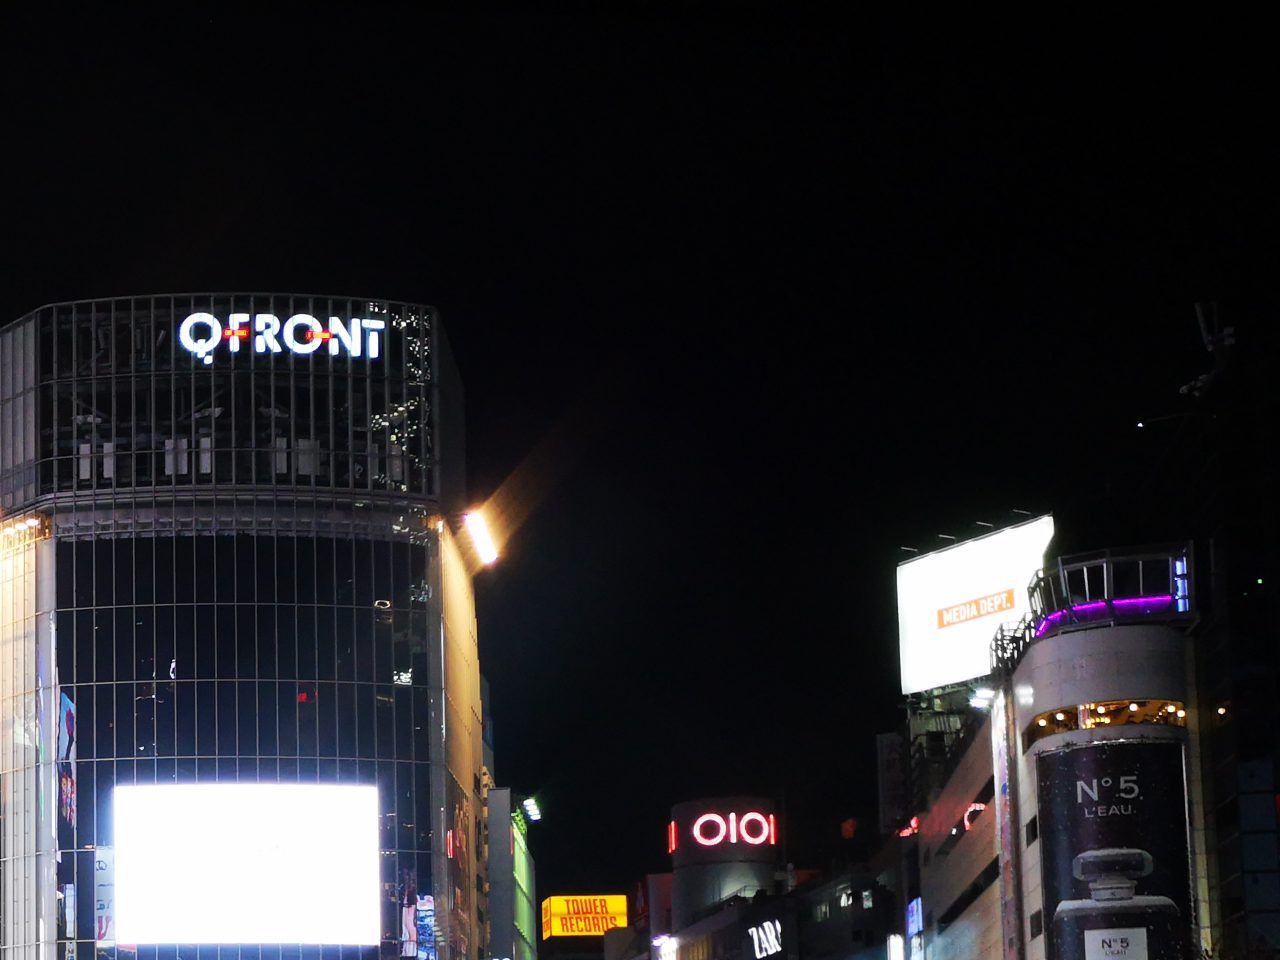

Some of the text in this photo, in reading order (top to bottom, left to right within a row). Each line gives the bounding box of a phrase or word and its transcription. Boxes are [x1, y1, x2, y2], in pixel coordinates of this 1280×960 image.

[179, 312, 386, 364] QFRONT
[942, 595, 1012, 626] MEDIA DEPT.
[563, 898, 609, 915] TOWER
[560, 916, 618, 933] RECORDS
